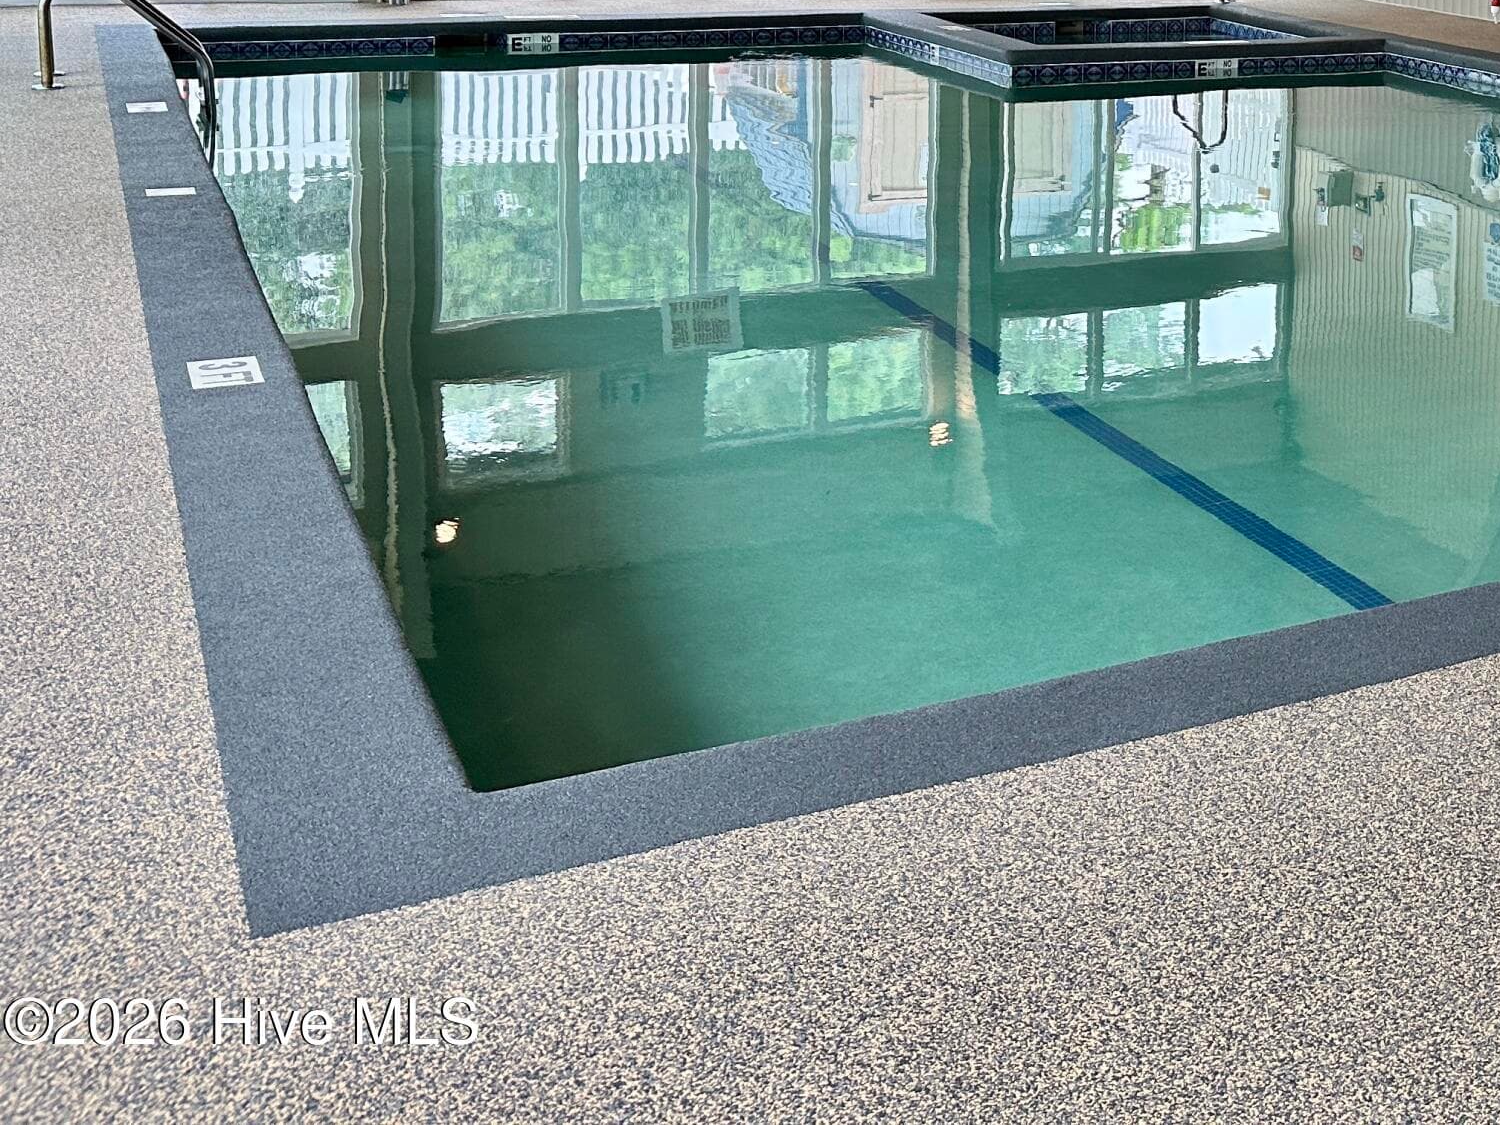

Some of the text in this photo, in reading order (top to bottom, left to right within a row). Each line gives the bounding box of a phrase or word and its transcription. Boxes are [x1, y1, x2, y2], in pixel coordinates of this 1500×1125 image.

[541, 35, 552, 43] NO
[198, 361, 254, 385] 3 FT
